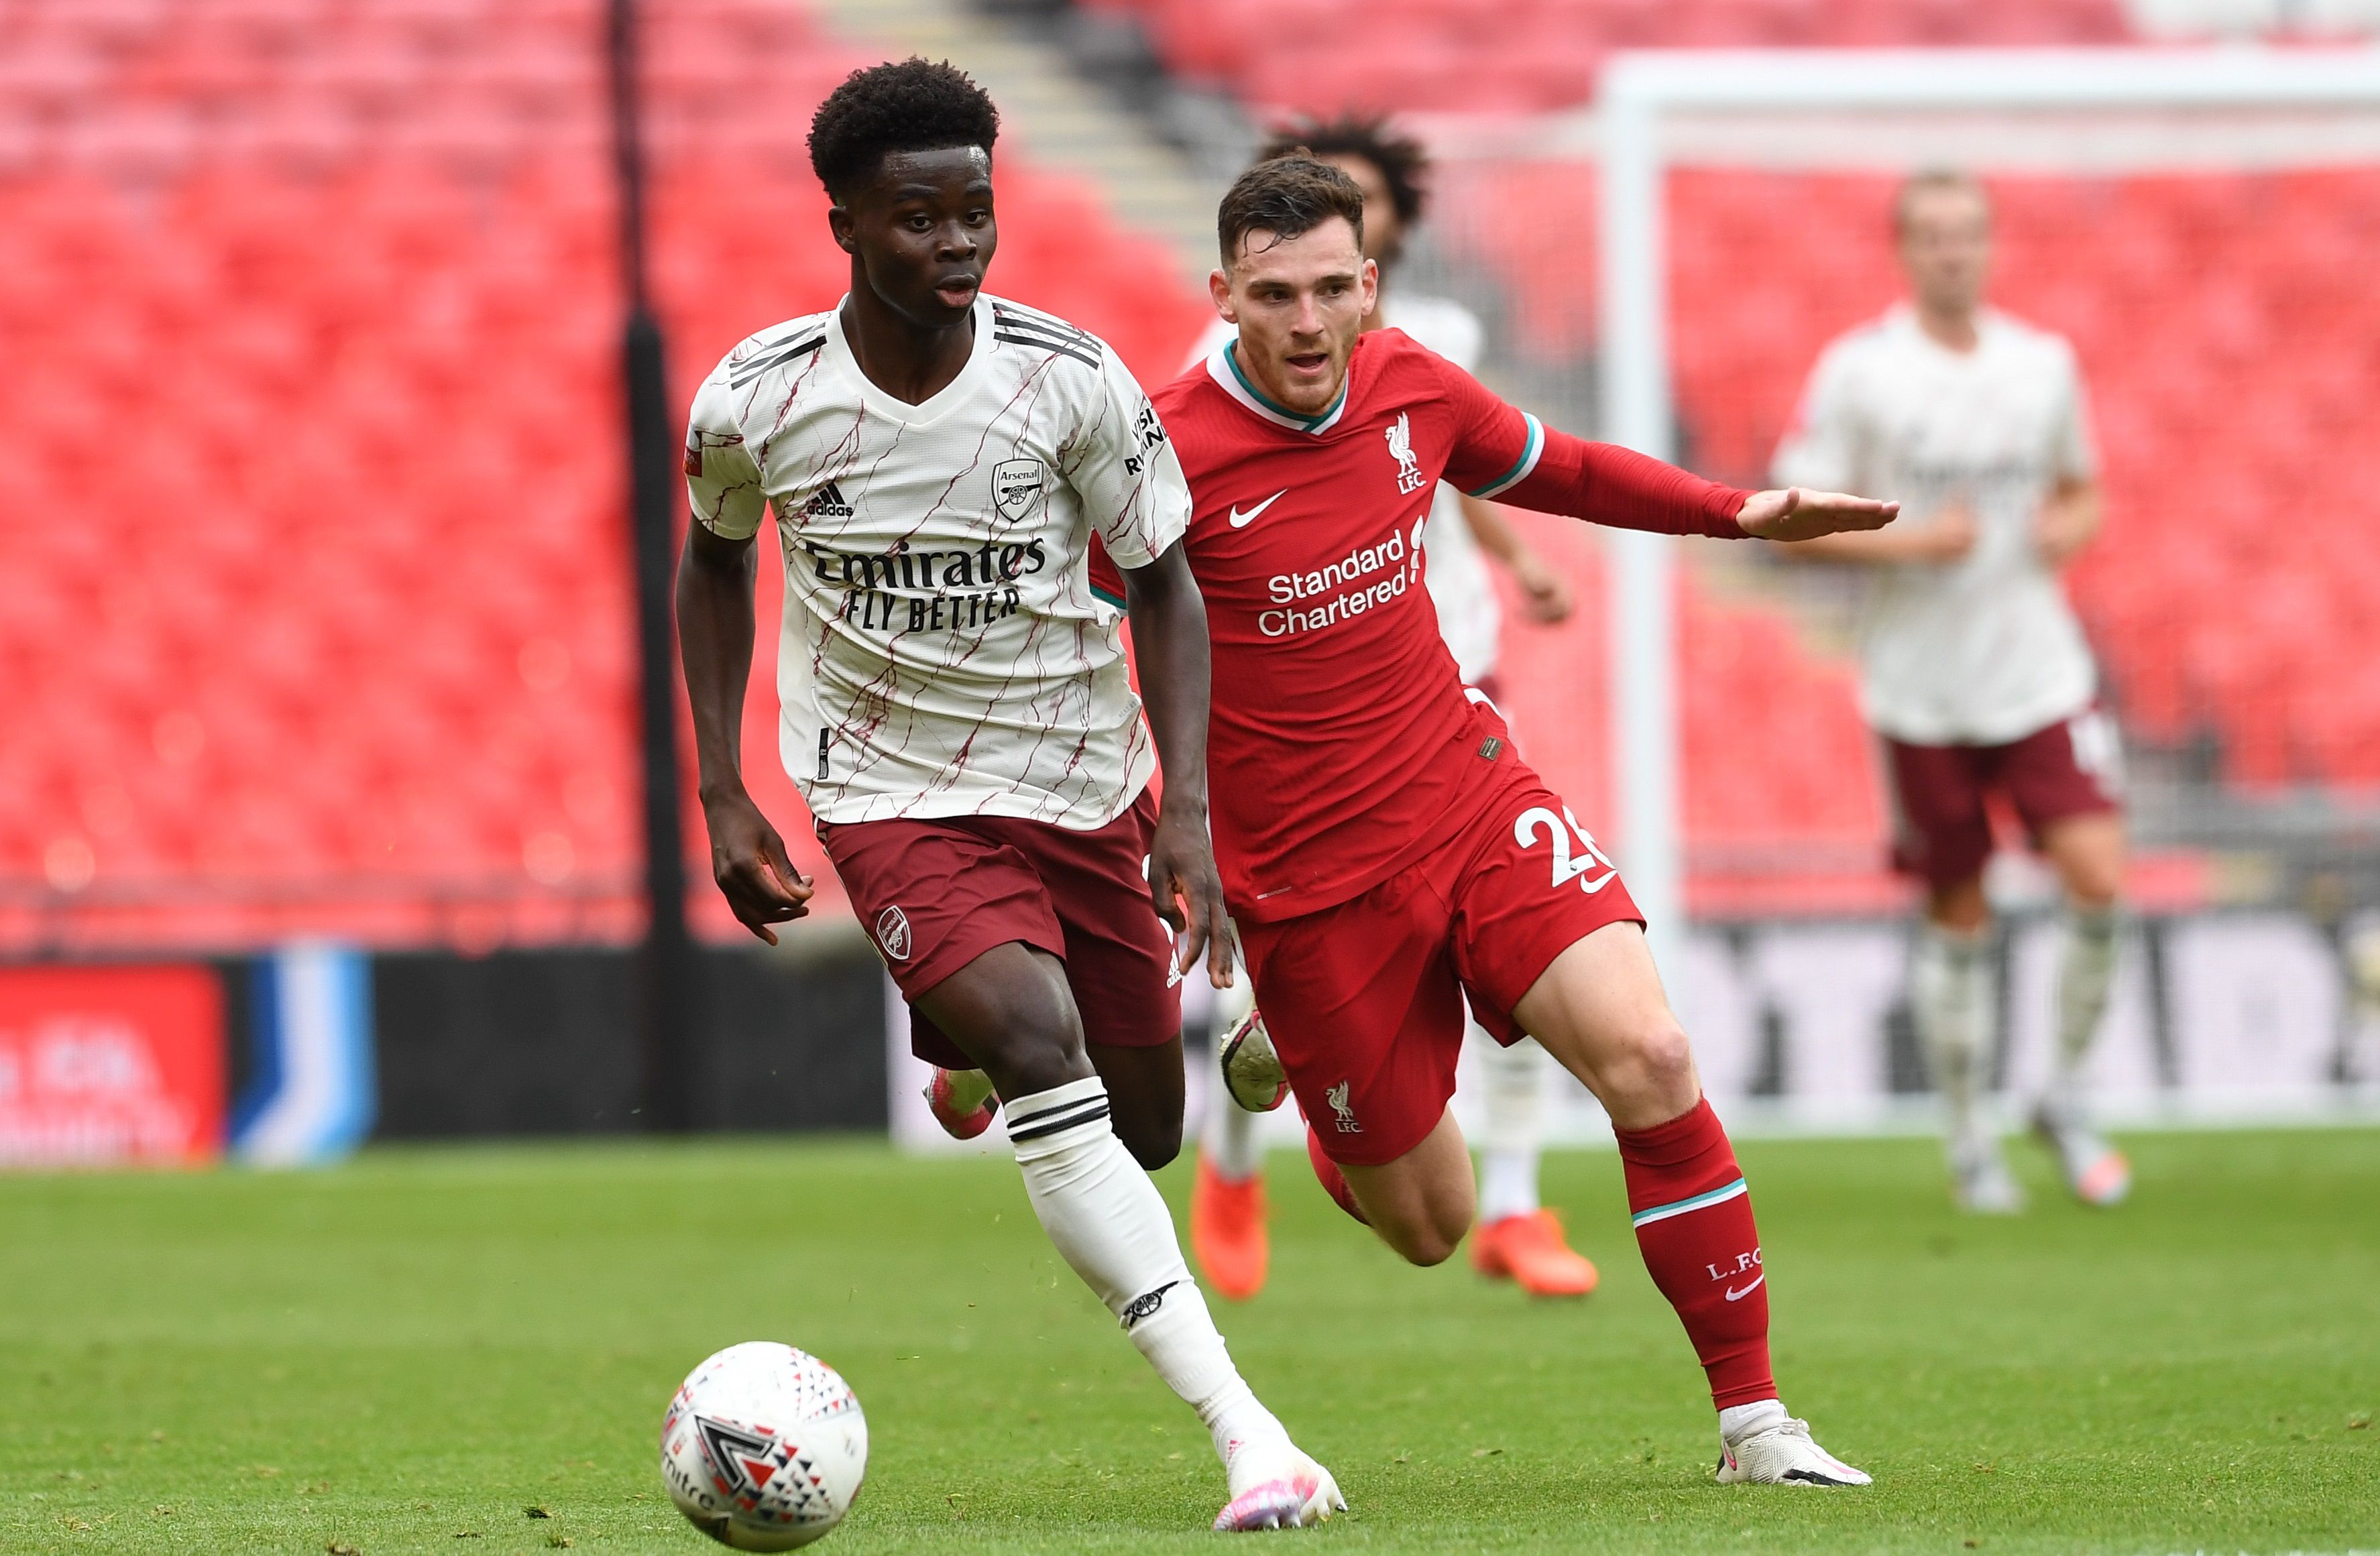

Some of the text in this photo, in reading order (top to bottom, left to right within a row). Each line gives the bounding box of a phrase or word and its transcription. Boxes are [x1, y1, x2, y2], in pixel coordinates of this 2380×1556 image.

[1000, 469, 1037, 481] Arsenal
[807, 502, 853, 516] adidas
[805, 538, 1045, 588] Emirates
[1267, 528, 1404, 603] Standard
[846, 588, 1019, 632] FLY BETTER
[1258, 564, 1406, 636] Chartered
